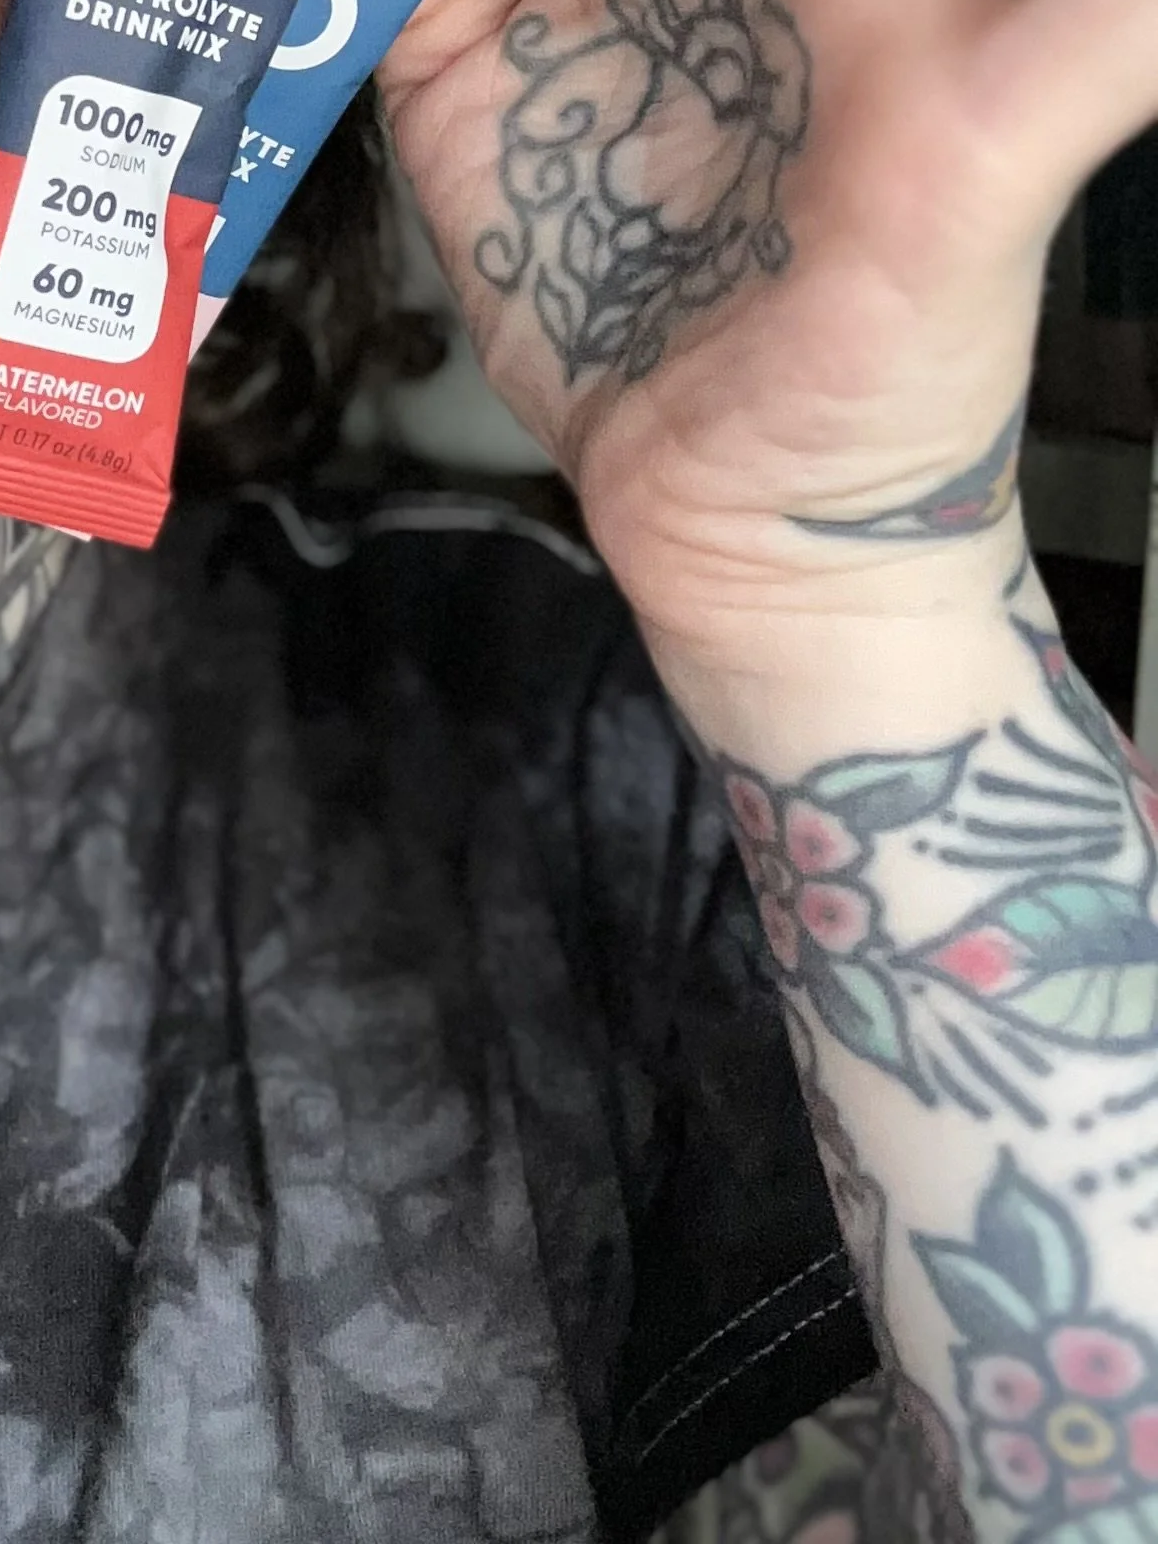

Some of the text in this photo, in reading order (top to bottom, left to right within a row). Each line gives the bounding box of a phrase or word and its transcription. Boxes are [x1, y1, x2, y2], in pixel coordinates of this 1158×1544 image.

[177, 25, 229, 62] MIX
[80, 146, 146, 175] SODIUM
[42, 178, 157, 238] 200 mg
[41, 222, 150, 260] POTASSIUM
[33, 263, 134, 317] 60 mg
[13, 301, 136, 342] MAGNESIUM
[13, 429, 51, 451] 0.17
[53, 440, 75, 457] oz
[78, 444, 133, 473] (4.8g)
